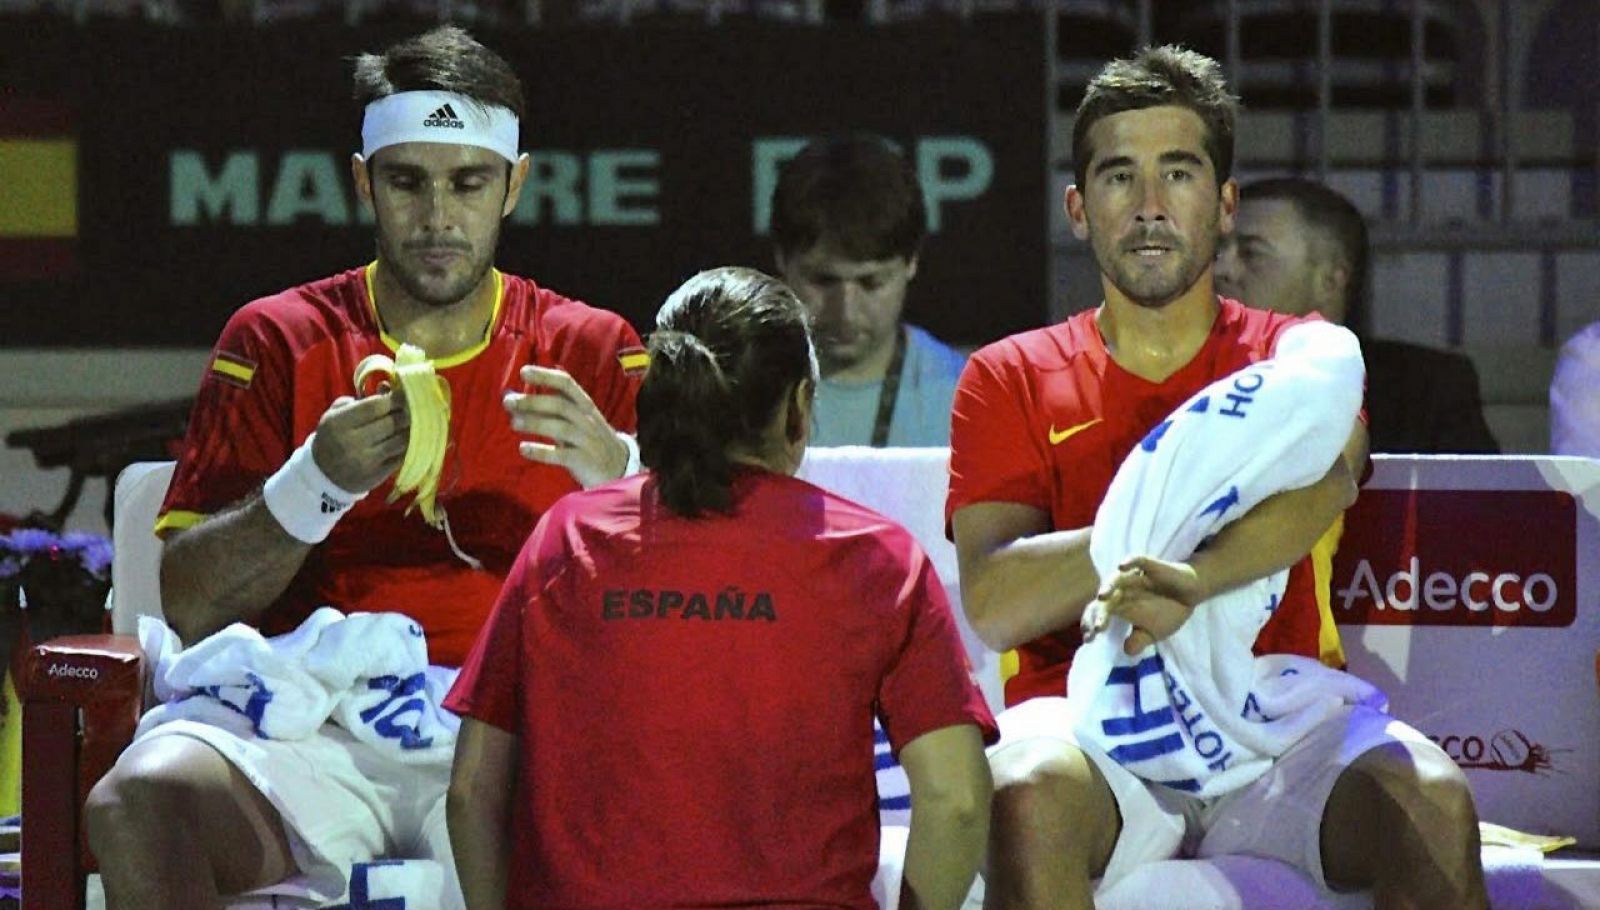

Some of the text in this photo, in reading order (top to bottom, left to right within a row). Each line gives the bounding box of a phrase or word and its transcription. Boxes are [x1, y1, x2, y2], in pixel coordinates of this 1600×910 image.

[423, 117, 465, 130] adidas
[168, 150, 663, 226] MARE
[1337, 556, 1558, 612] Adecco
[602, 585, 777, 621] ESPAÑA
[48, 663, 99, 679] Adecco
[1427, 735, 1485, 761] co
